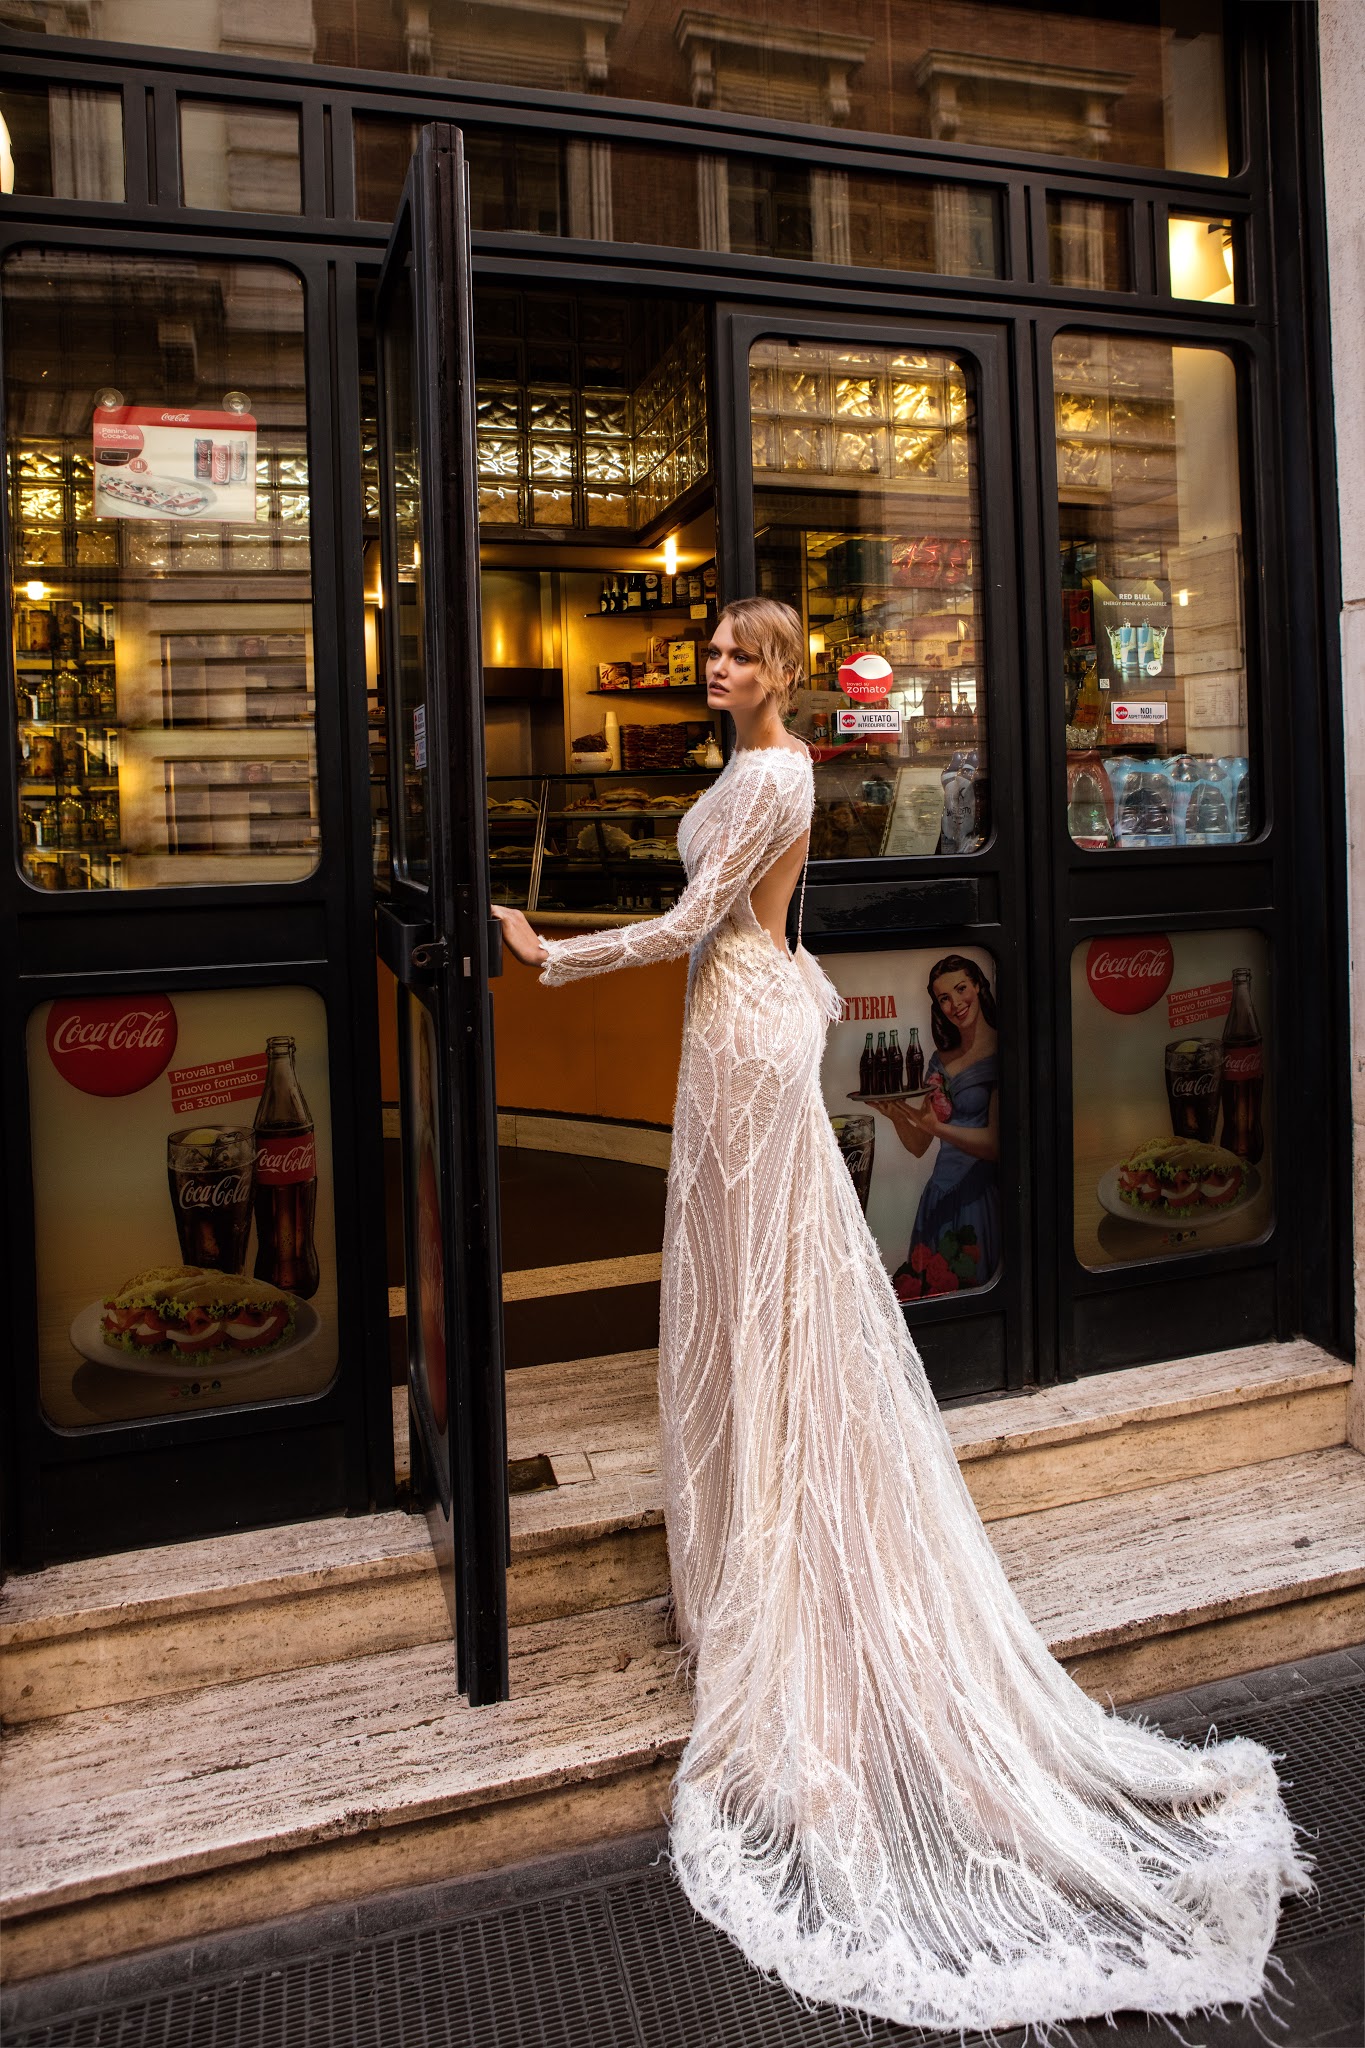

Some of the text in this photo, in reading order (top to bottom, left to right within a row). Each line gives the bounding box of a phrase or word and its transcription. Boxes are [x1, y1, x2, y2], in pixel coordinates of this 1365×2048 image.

[102, 432, 139, 440] Coca-Cola
[846, 685, 887, 694] zomato
[862, 714, 891, 722] VIETATO
[1140, 707, 1152, 715] NOI
[1090, 949, 1170, 981] Coca-Cola
[1170, 987, 1212, 1002] Provala nel
[1172, 995, 1226, 1014] nuovo formato
[1173, 1011, 1209, 1027] da 330ml
[53, 1010, 172, 1054] Coca-Cola
[174, 1060, 235, 1082] Provala nel
[177, 1071, 258, 1097] nuovo formato
[1172, 1073, 1219, 1098] Coca-Cola
[179, 1092, 232, 1112] da 330ml
[254, 1142, 315, 1174] Coca-Cola
[179, 1172, 251, 1209] Coca-Cola
